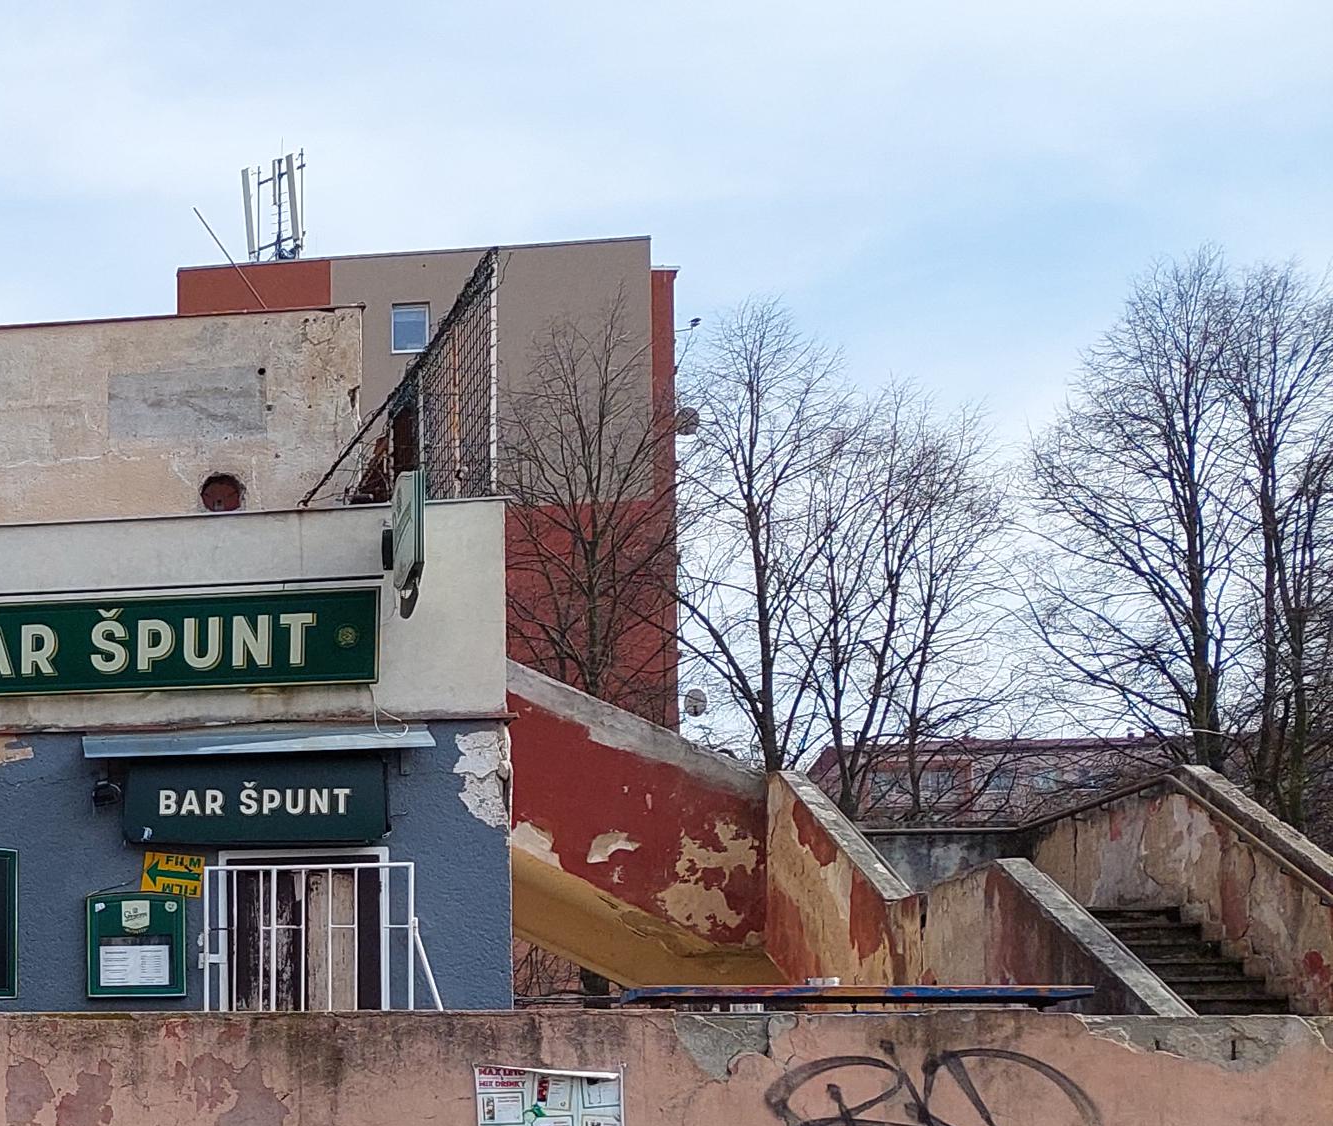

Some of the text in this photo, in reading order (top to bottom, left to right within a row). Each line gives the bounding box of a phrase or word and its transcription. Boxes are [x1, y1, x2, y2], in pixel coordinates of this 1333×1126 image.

[89, 607, 317, 675] ŠPUNT
[158, 780, 353, 816] BAR ŠPUNT
[165, 855, 202, 868] FILM
[162, 882, 198, 896] FILM
